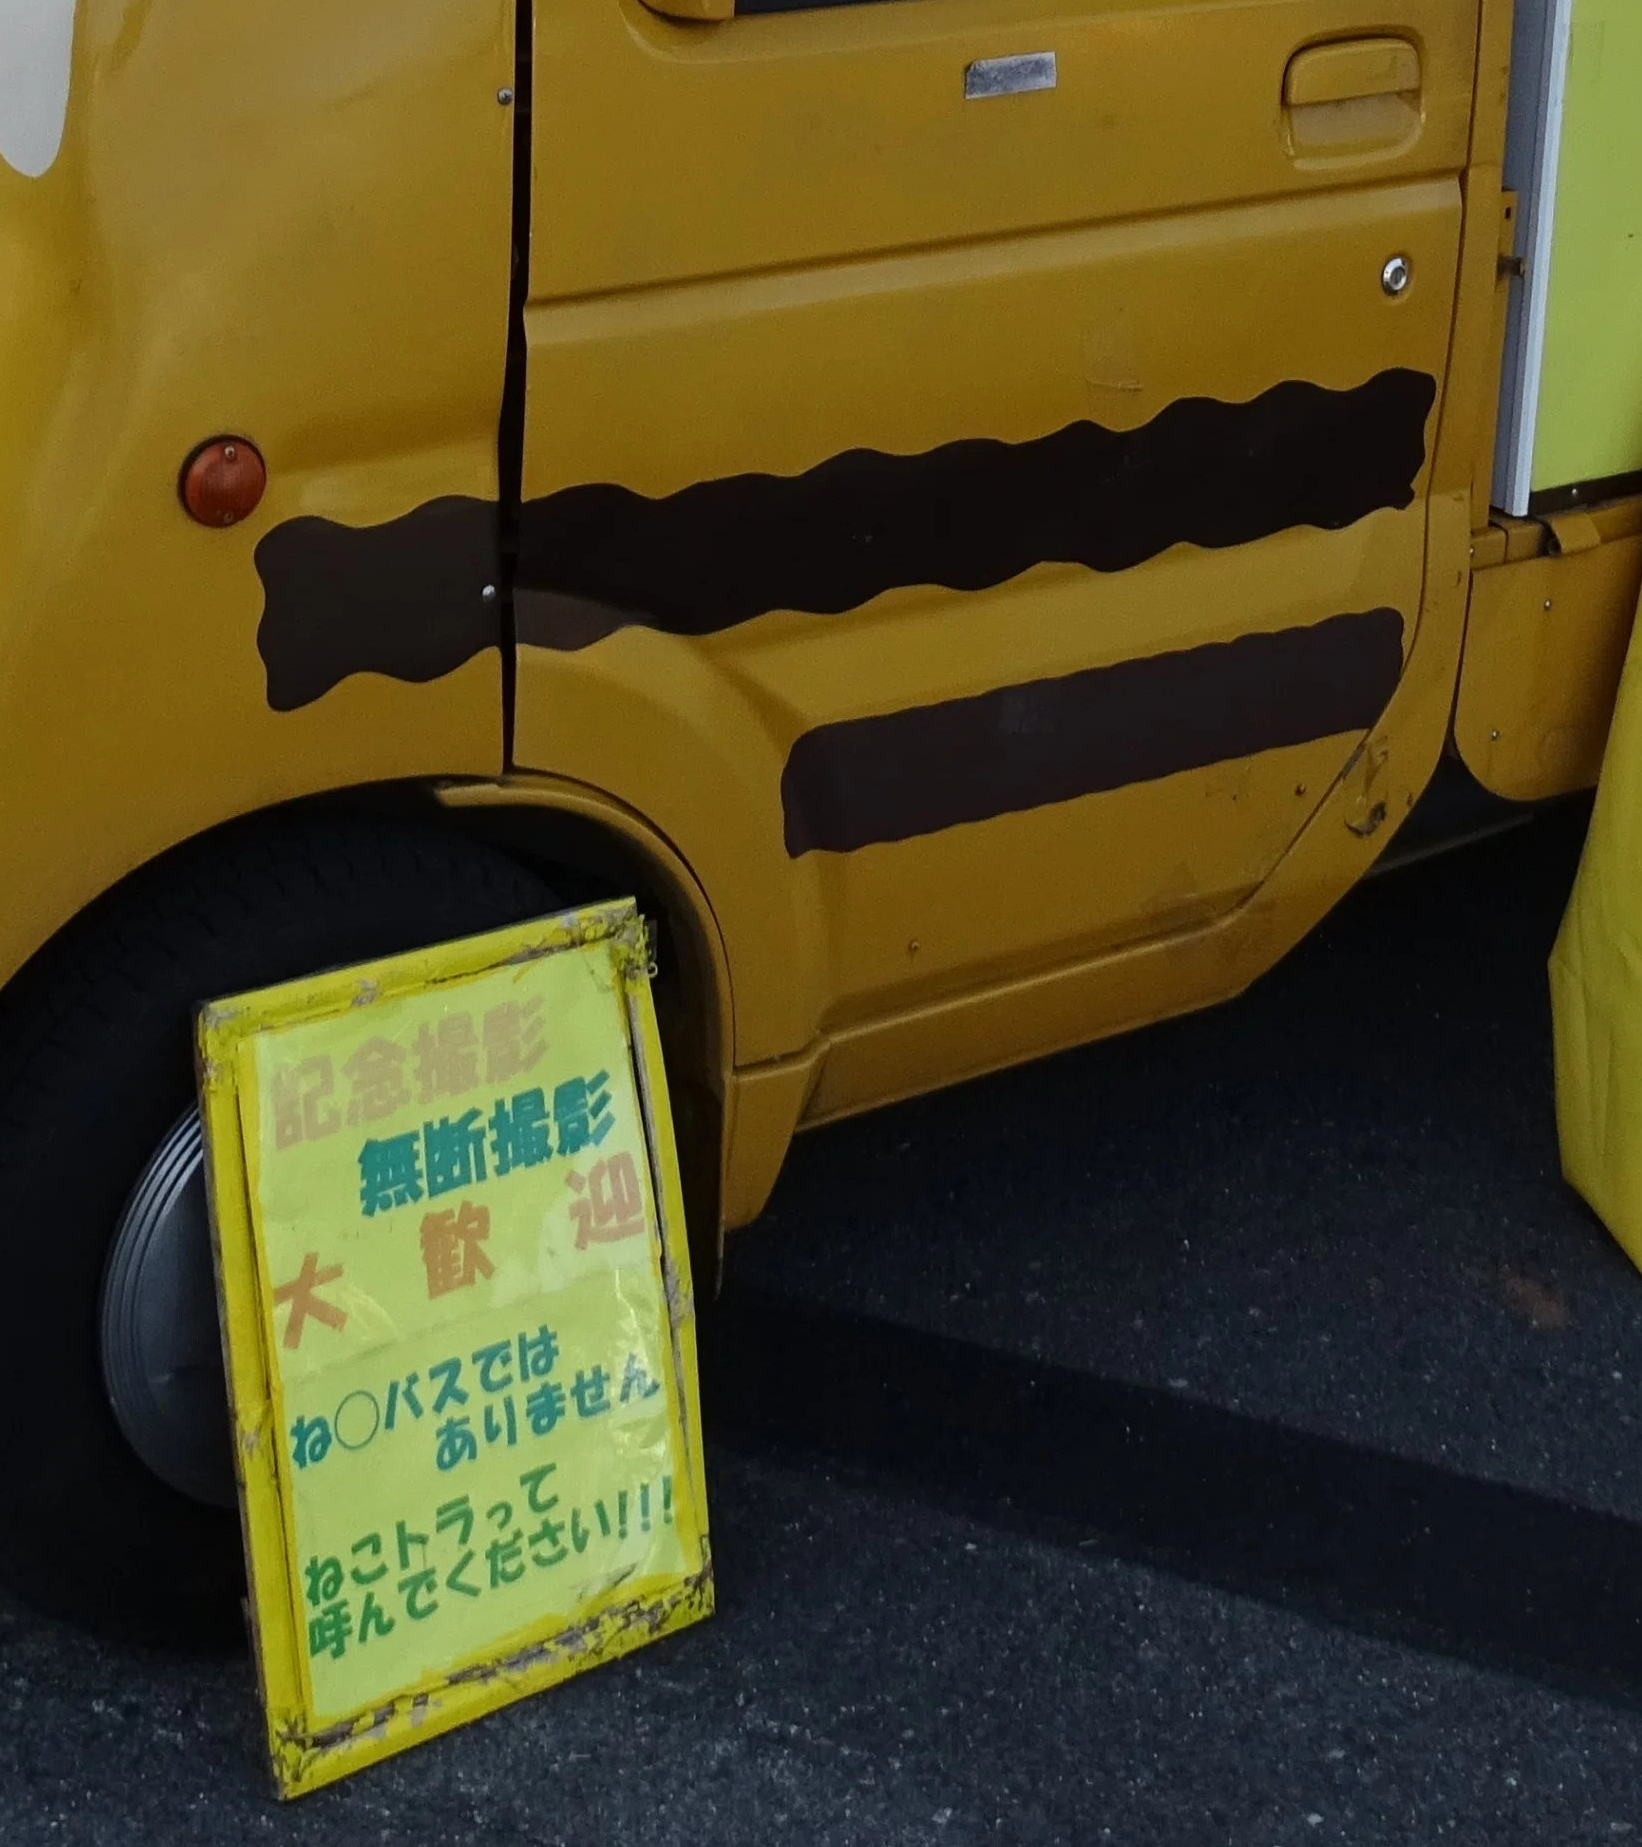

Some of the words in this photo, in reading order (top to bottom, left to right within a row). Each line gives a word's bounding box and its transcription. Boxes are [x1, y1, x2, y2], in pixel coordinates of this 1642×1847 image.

[270, 993, 549, 1150] 記念撮影
[358, 1069, 616, 1217] 無断撮影
[435, 1353, 660, 1471] ありません
[305, 1462, 559, 1606] ねこトラって
